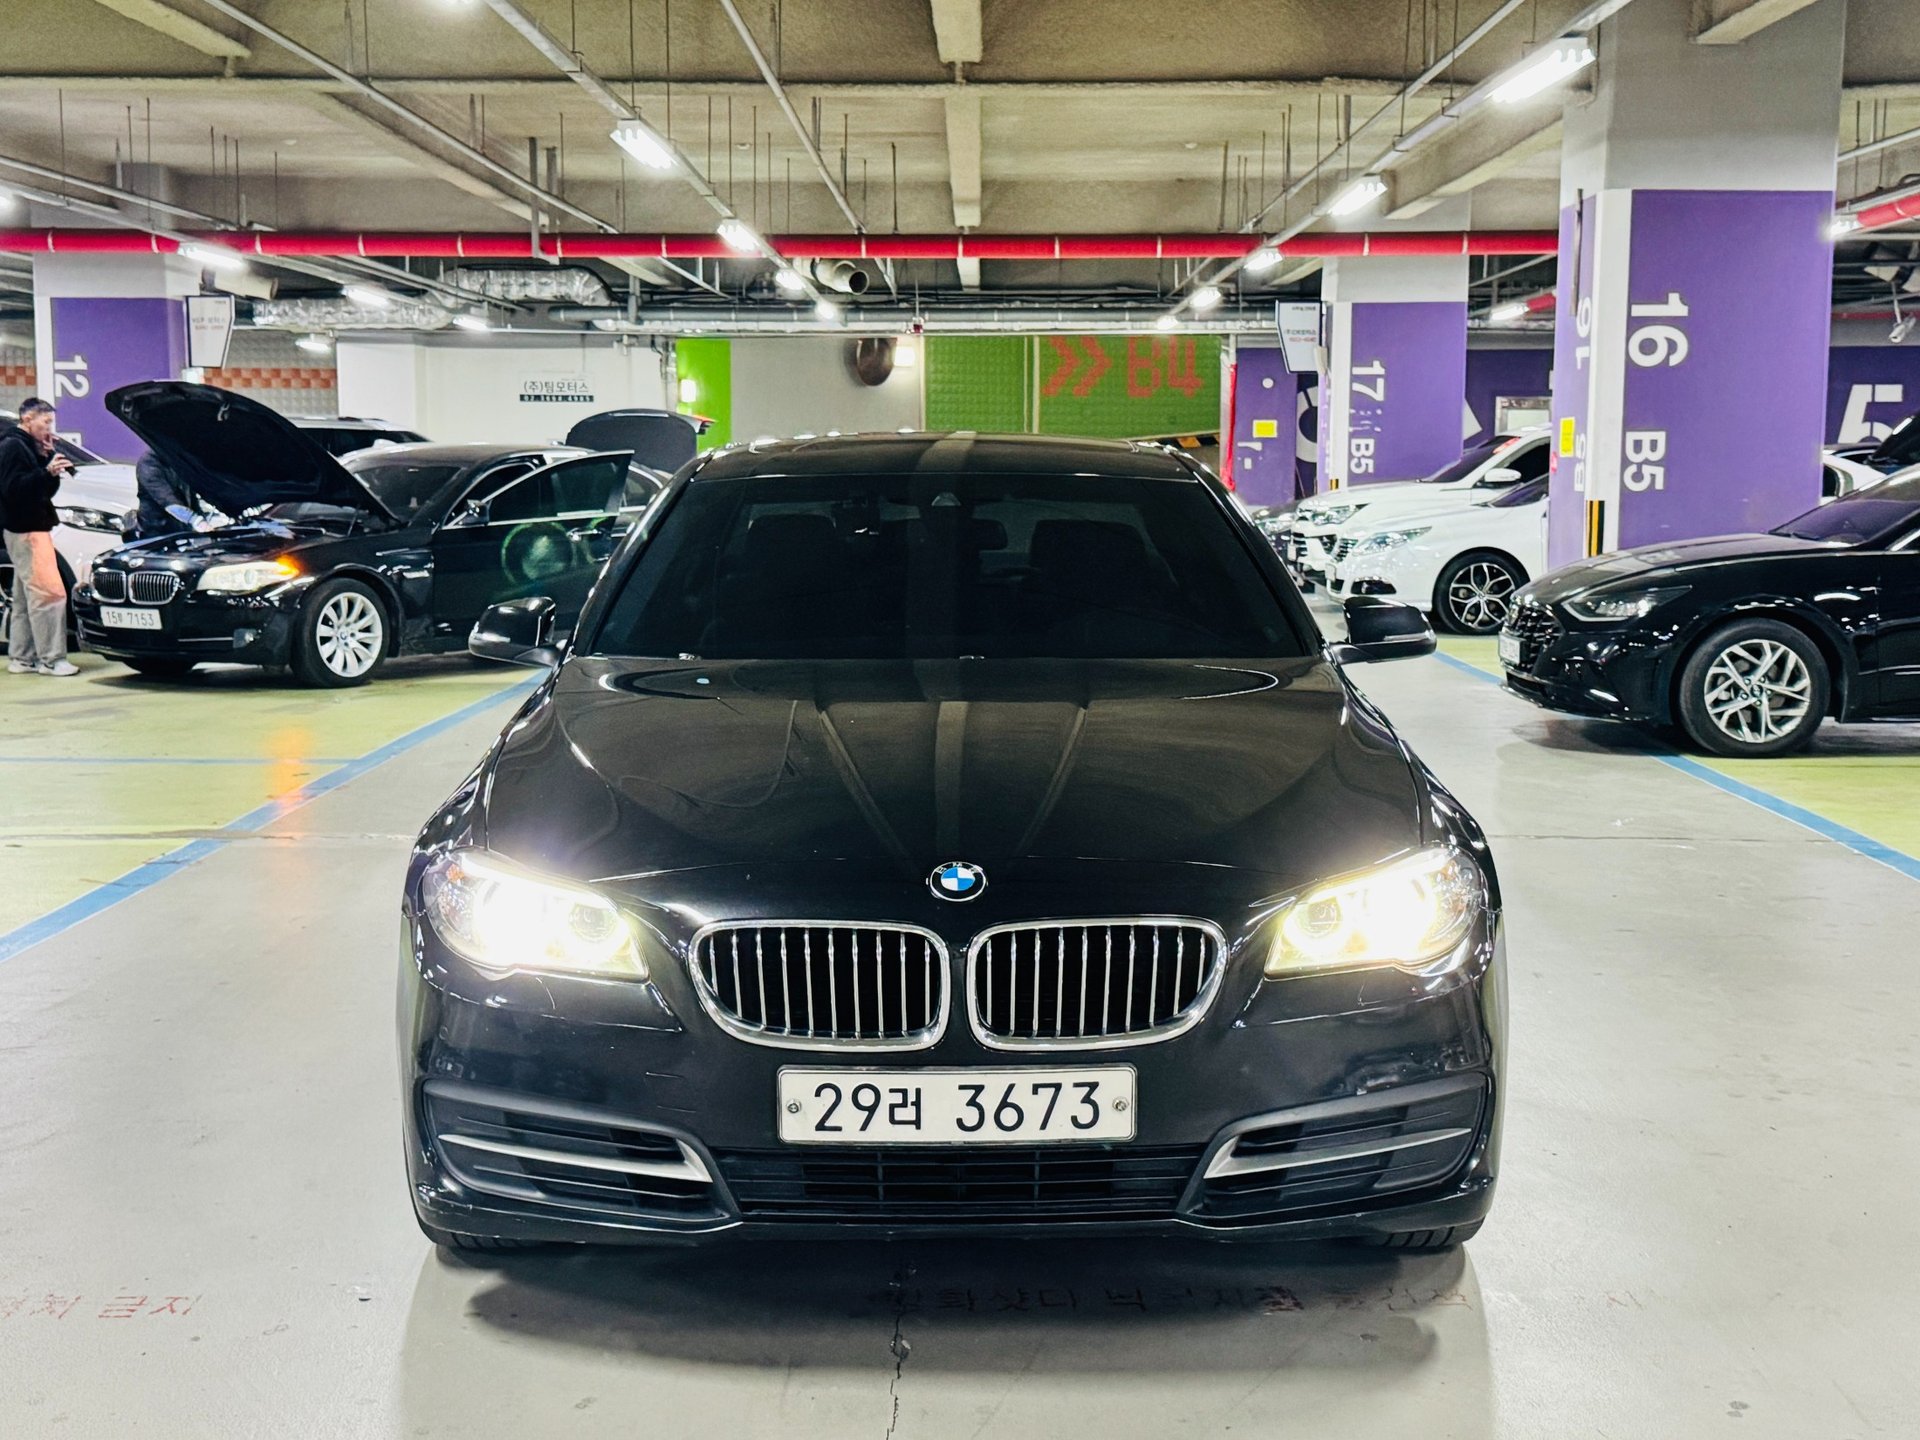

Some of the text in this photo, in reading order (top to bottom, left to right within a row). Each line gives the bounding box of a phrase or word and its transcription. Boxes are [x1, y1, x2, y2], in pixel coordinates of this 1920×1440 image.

[1628, 292, 1689, 367] 16
[54, 354, 90, 398] 12
[1128, 336, 1204, 397] B4
[1351, 360, 1386, 402] 17
[1350, 438, 1375, 474] B5
[1623, 431, 1667, 492] B5
[814, 1081, 1101, 1132] 29러 3673
